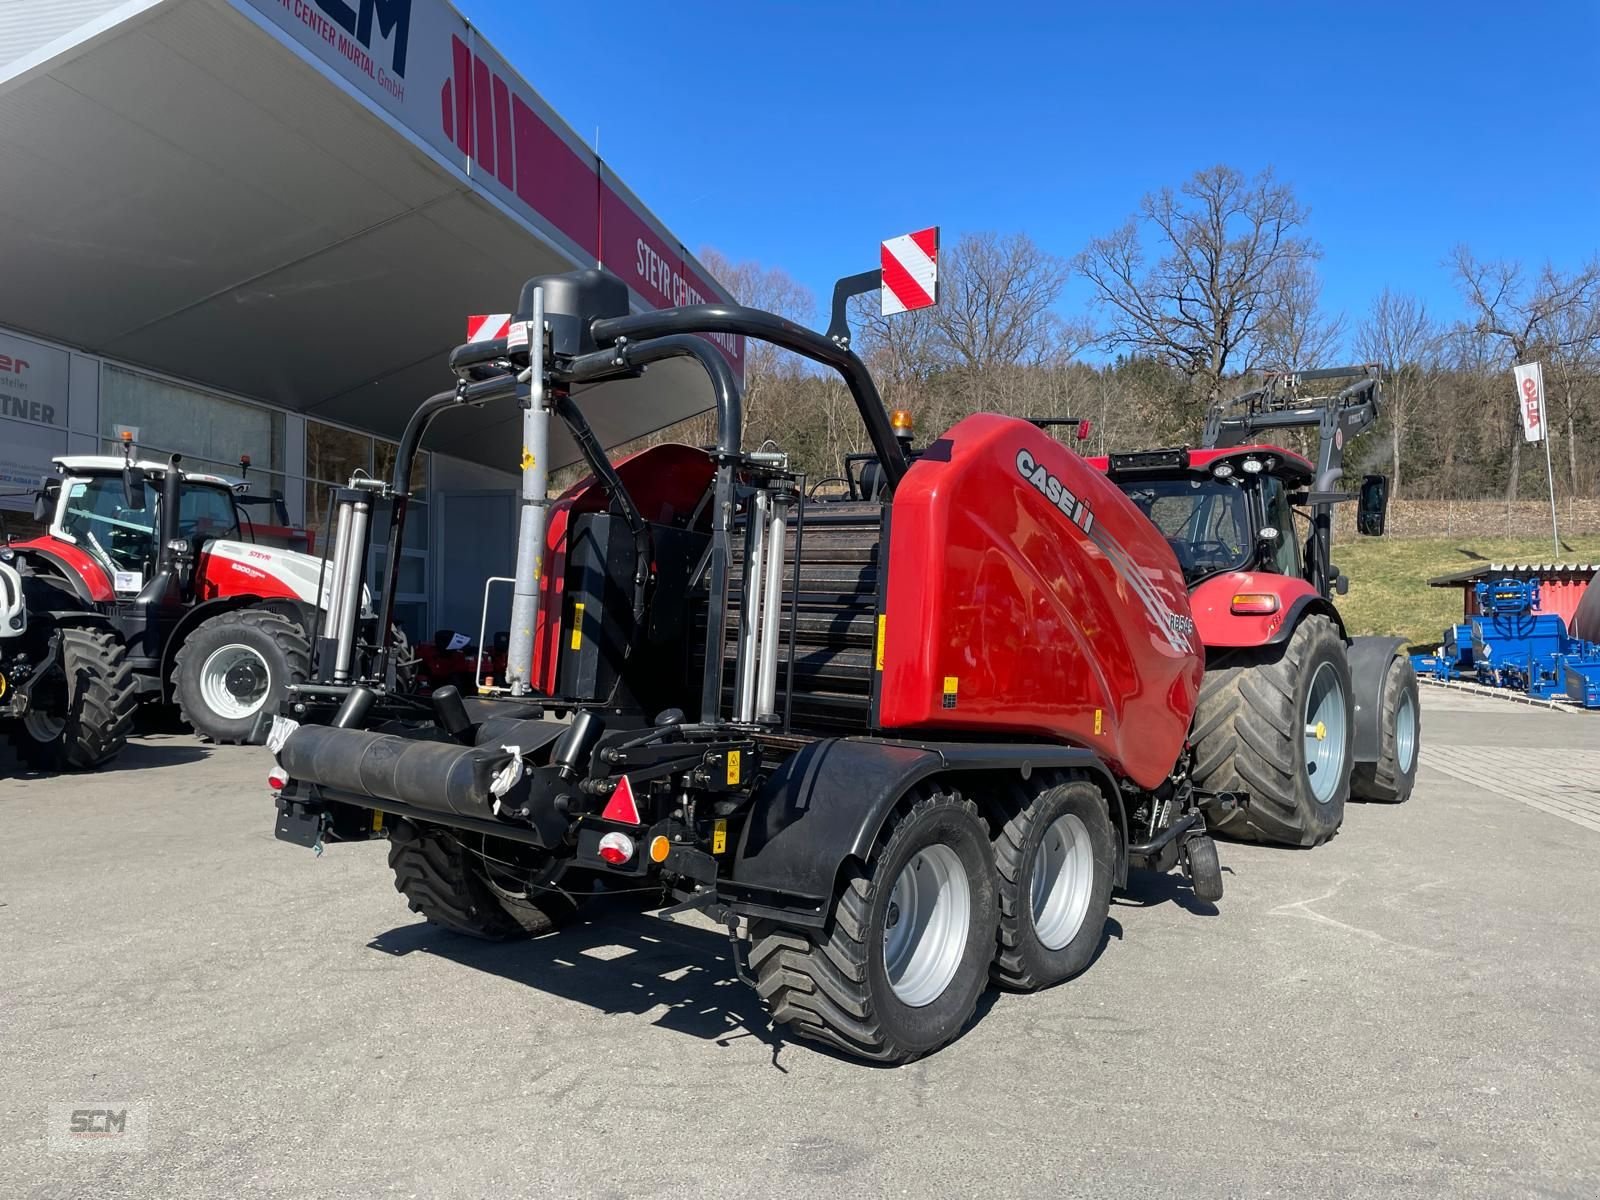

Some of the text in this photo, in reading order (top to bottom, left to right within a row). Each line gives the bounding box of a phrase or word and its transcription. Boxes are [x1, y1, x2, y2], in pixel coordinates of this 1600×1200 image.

[294, 0, 405, 102] CENTER MURTAL GmbH
[636, 238, 671, 300] STEYR
[1016, 448, 1077, 518] CASE
[248, 551, 271, 560] STEYR
